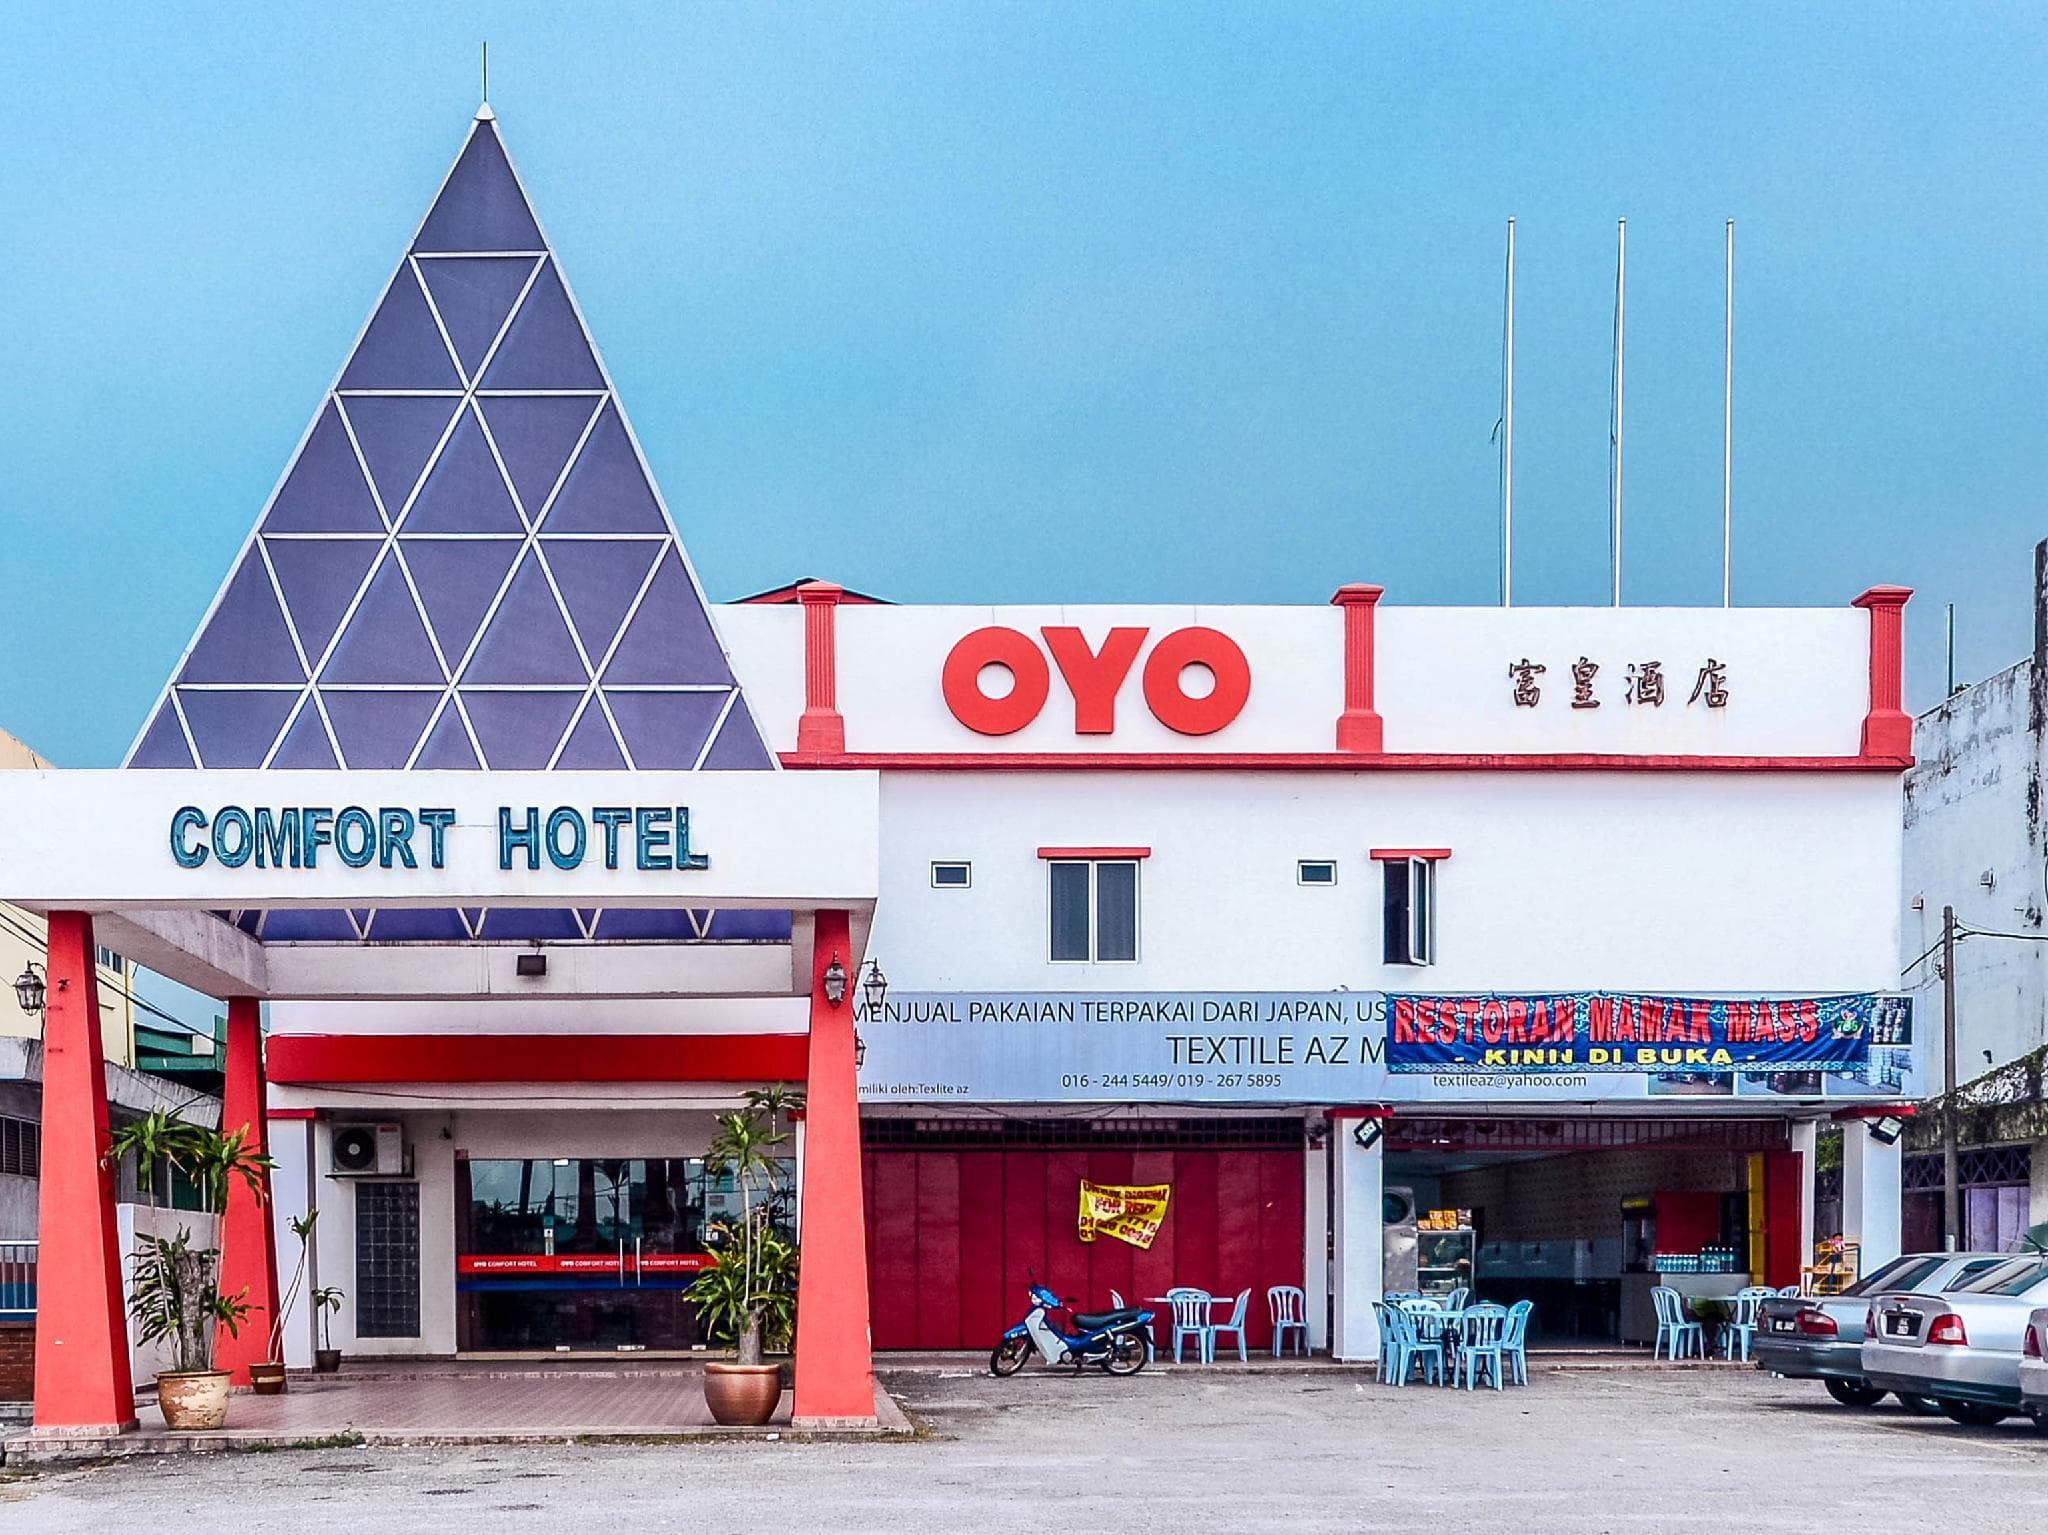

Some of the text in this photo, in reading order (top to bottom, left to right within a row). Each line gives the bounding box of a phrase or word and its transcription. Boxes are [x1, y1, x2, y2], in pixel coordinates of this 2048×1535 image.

[942, 626, 1251, 736] OYO
[1509, 656, 1730, 708] 富皇酒店
[170, 805, 709, 870] COMFORT HOTEL
[968, 1001, 1075, 1022] PAKAIAN
[1083, 1001, 1195, 1022] TERPAKAI
[1203, 1001, 1260, 1022] DARI
[1264, 1001, 1348, 1025] JAPAN,
[1356, 1001, 1387, 1022] US
[1394, 998, 1818, 1045] RESTORAN MAMAK MASS
[1167, 1037, 1295, 1065] TEXTILE
[1304, 1037, 1349, 1064] AZ
[1589, 1048, 1621, 1065] DI
[1637, 1048, 1735, 1065] BUKA
[957, 1086, 969, 1096] az
[1062, 1075, 1088, 1089] 016
[1102, 1075, 1128, 1089] 244
[1132, 1075, 1174, 1089] 5449/
[1177, 1075, 1202, 1089] 019
[1217, 1075, 1243, 1089] 267
[1247, 1075, 1282, 1089] 5895
[1432, 1072, 1588, 1089] textileaz@yahoo.com
